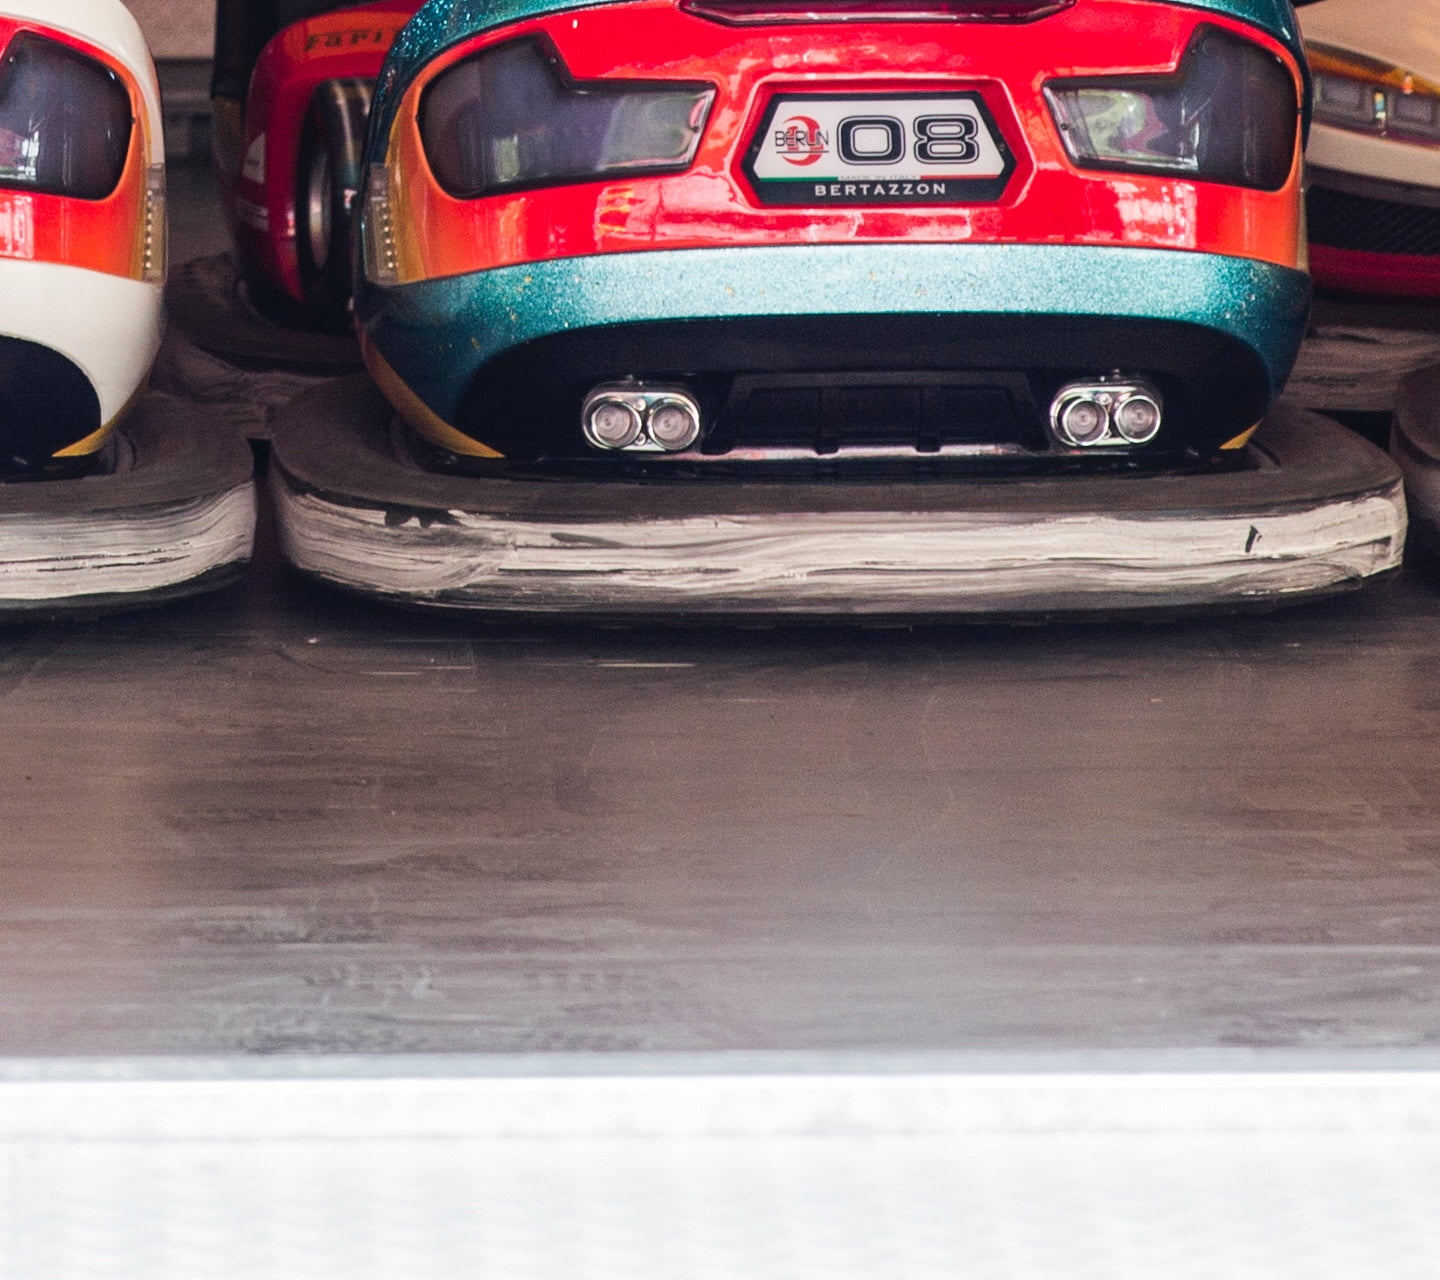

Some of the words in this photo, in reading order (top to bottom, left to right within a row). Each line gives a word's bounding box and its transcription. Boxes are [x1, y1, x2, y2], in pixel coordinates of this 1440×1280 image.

[774, 130, 829, 147] BERLIN
[836, 114, 980, 166] 08
[815, 183, 946, 196] BERTAZZON
